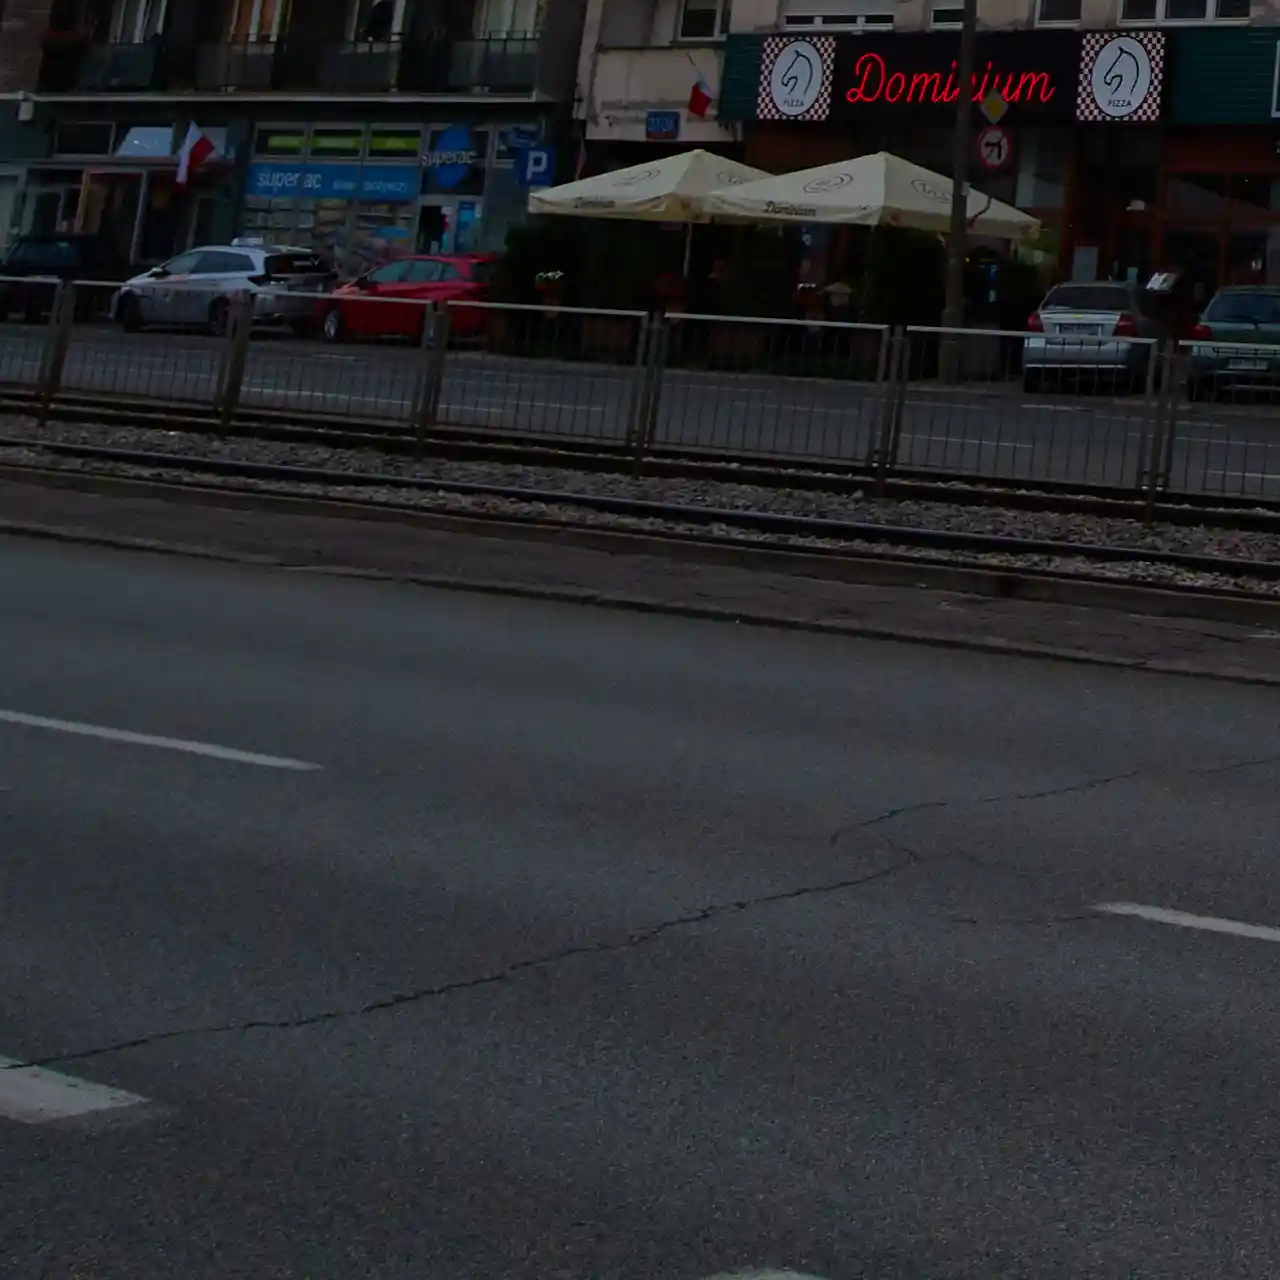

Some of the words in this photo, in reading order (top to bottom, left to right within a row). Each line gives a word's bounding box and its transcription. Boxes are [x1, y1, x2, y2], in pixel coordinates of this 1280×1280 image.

[844, 51, 1056, 106] Domiium
[1107, 99, 1132, 108] PIZZA
[526, 151, 548, 181] P
